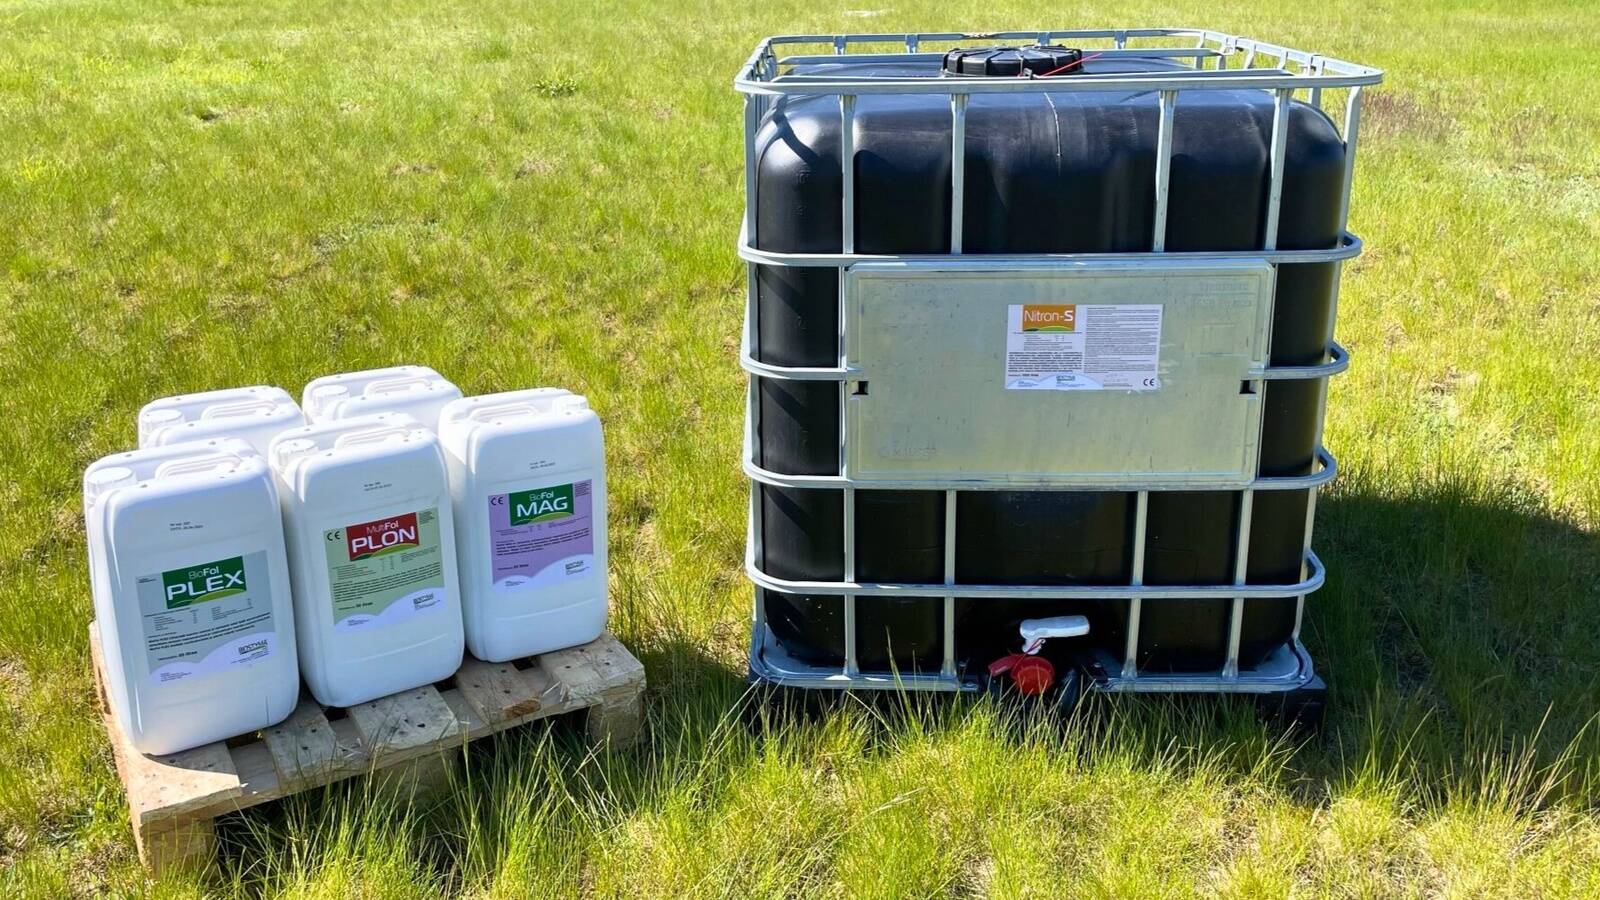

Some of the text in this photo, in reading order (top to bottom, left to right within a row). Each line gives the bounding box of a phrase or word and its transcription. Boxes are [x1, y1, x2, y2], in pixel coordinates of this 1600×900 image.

[1024, 310, 1074, 322] Nitron-S
[529, 491, 554, 502] BioFol
[517, 496, 568, 517] MAG
[366, 520, 399, 534] MultiFol
[351, 526, 416, 553] PLON
[188, 565, 219, 580] BioFol
[167, 570, 244, 600] PLEX
